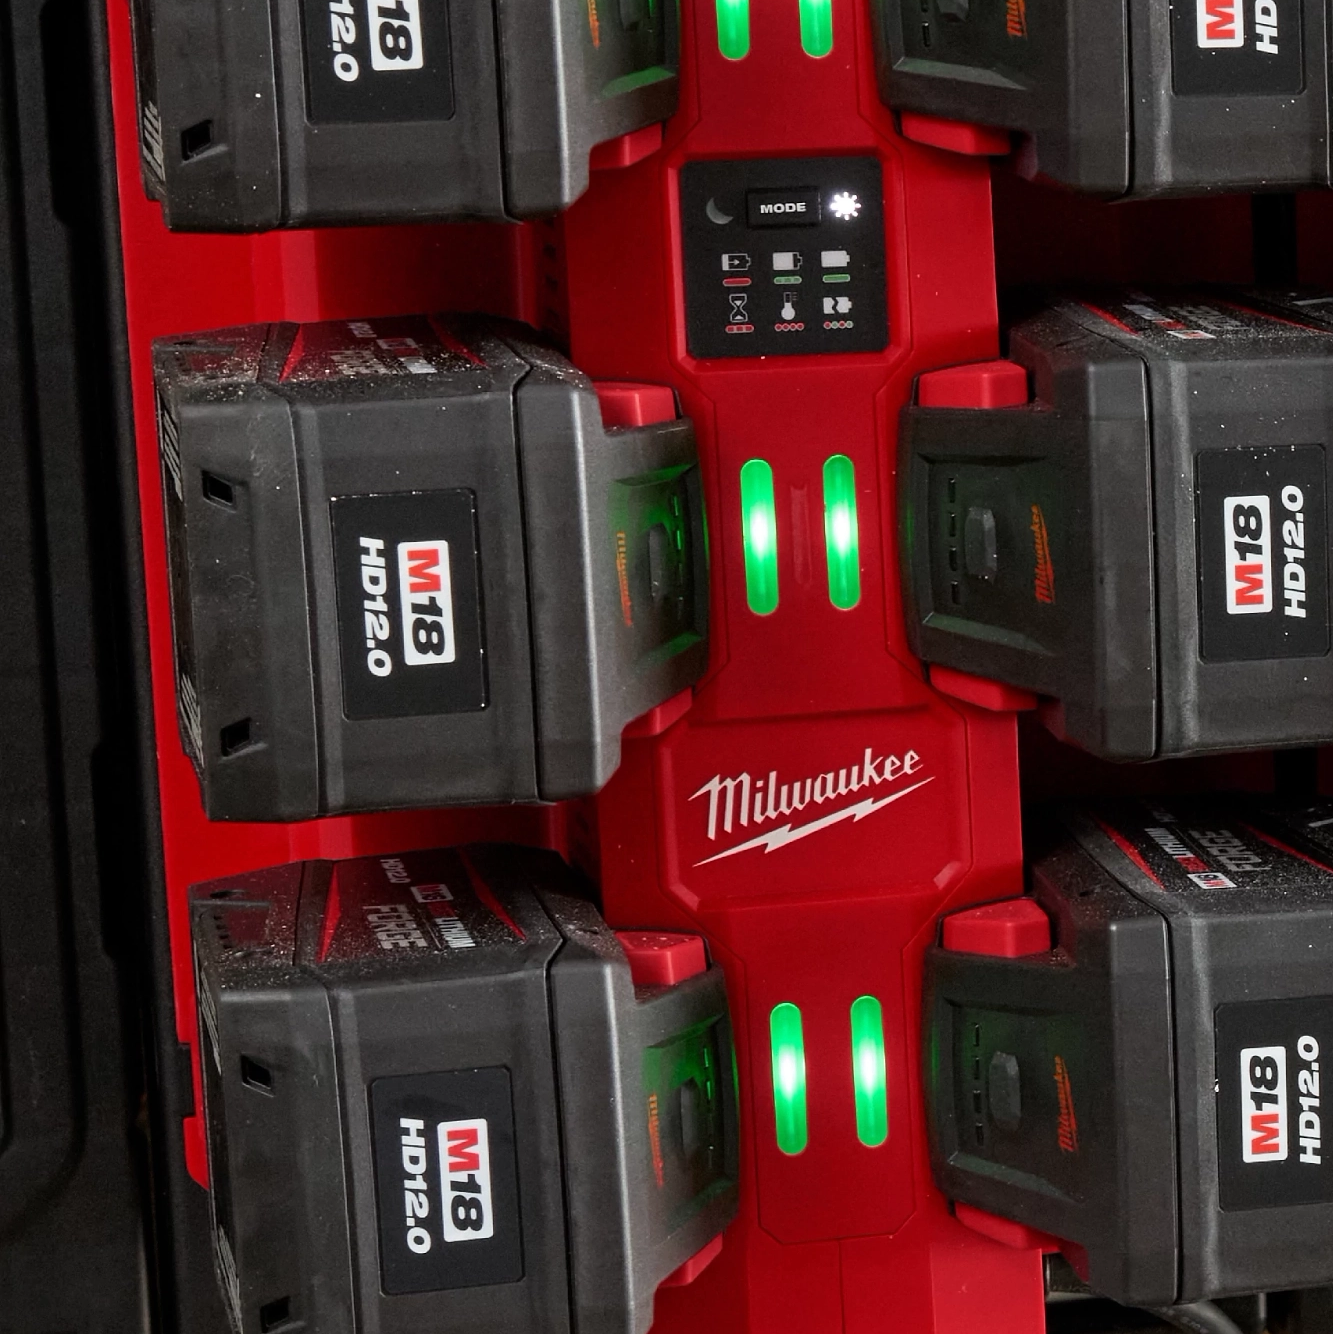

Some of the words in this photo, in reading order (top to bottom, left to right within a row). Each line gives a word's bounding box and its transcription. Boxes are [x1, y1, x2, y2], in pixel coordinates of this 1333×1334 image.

[760, 202, 807, 214] MODE
[406, 548, 446, 657] M18
[1235, 504, 1265, 605] M18
[1281, 484, 1306, 618] HD12.0
[359, 536, 393, 677] HD12.0
[688, 748, 924, 841] Milwaukee
[1250, 1055, 1280, 1155] M18
[1297, 1035, 1322, 1165] HD12.0
[399, 1118, 431, 1254] HD12.0
[446, 1128, 484, 1232] M18
